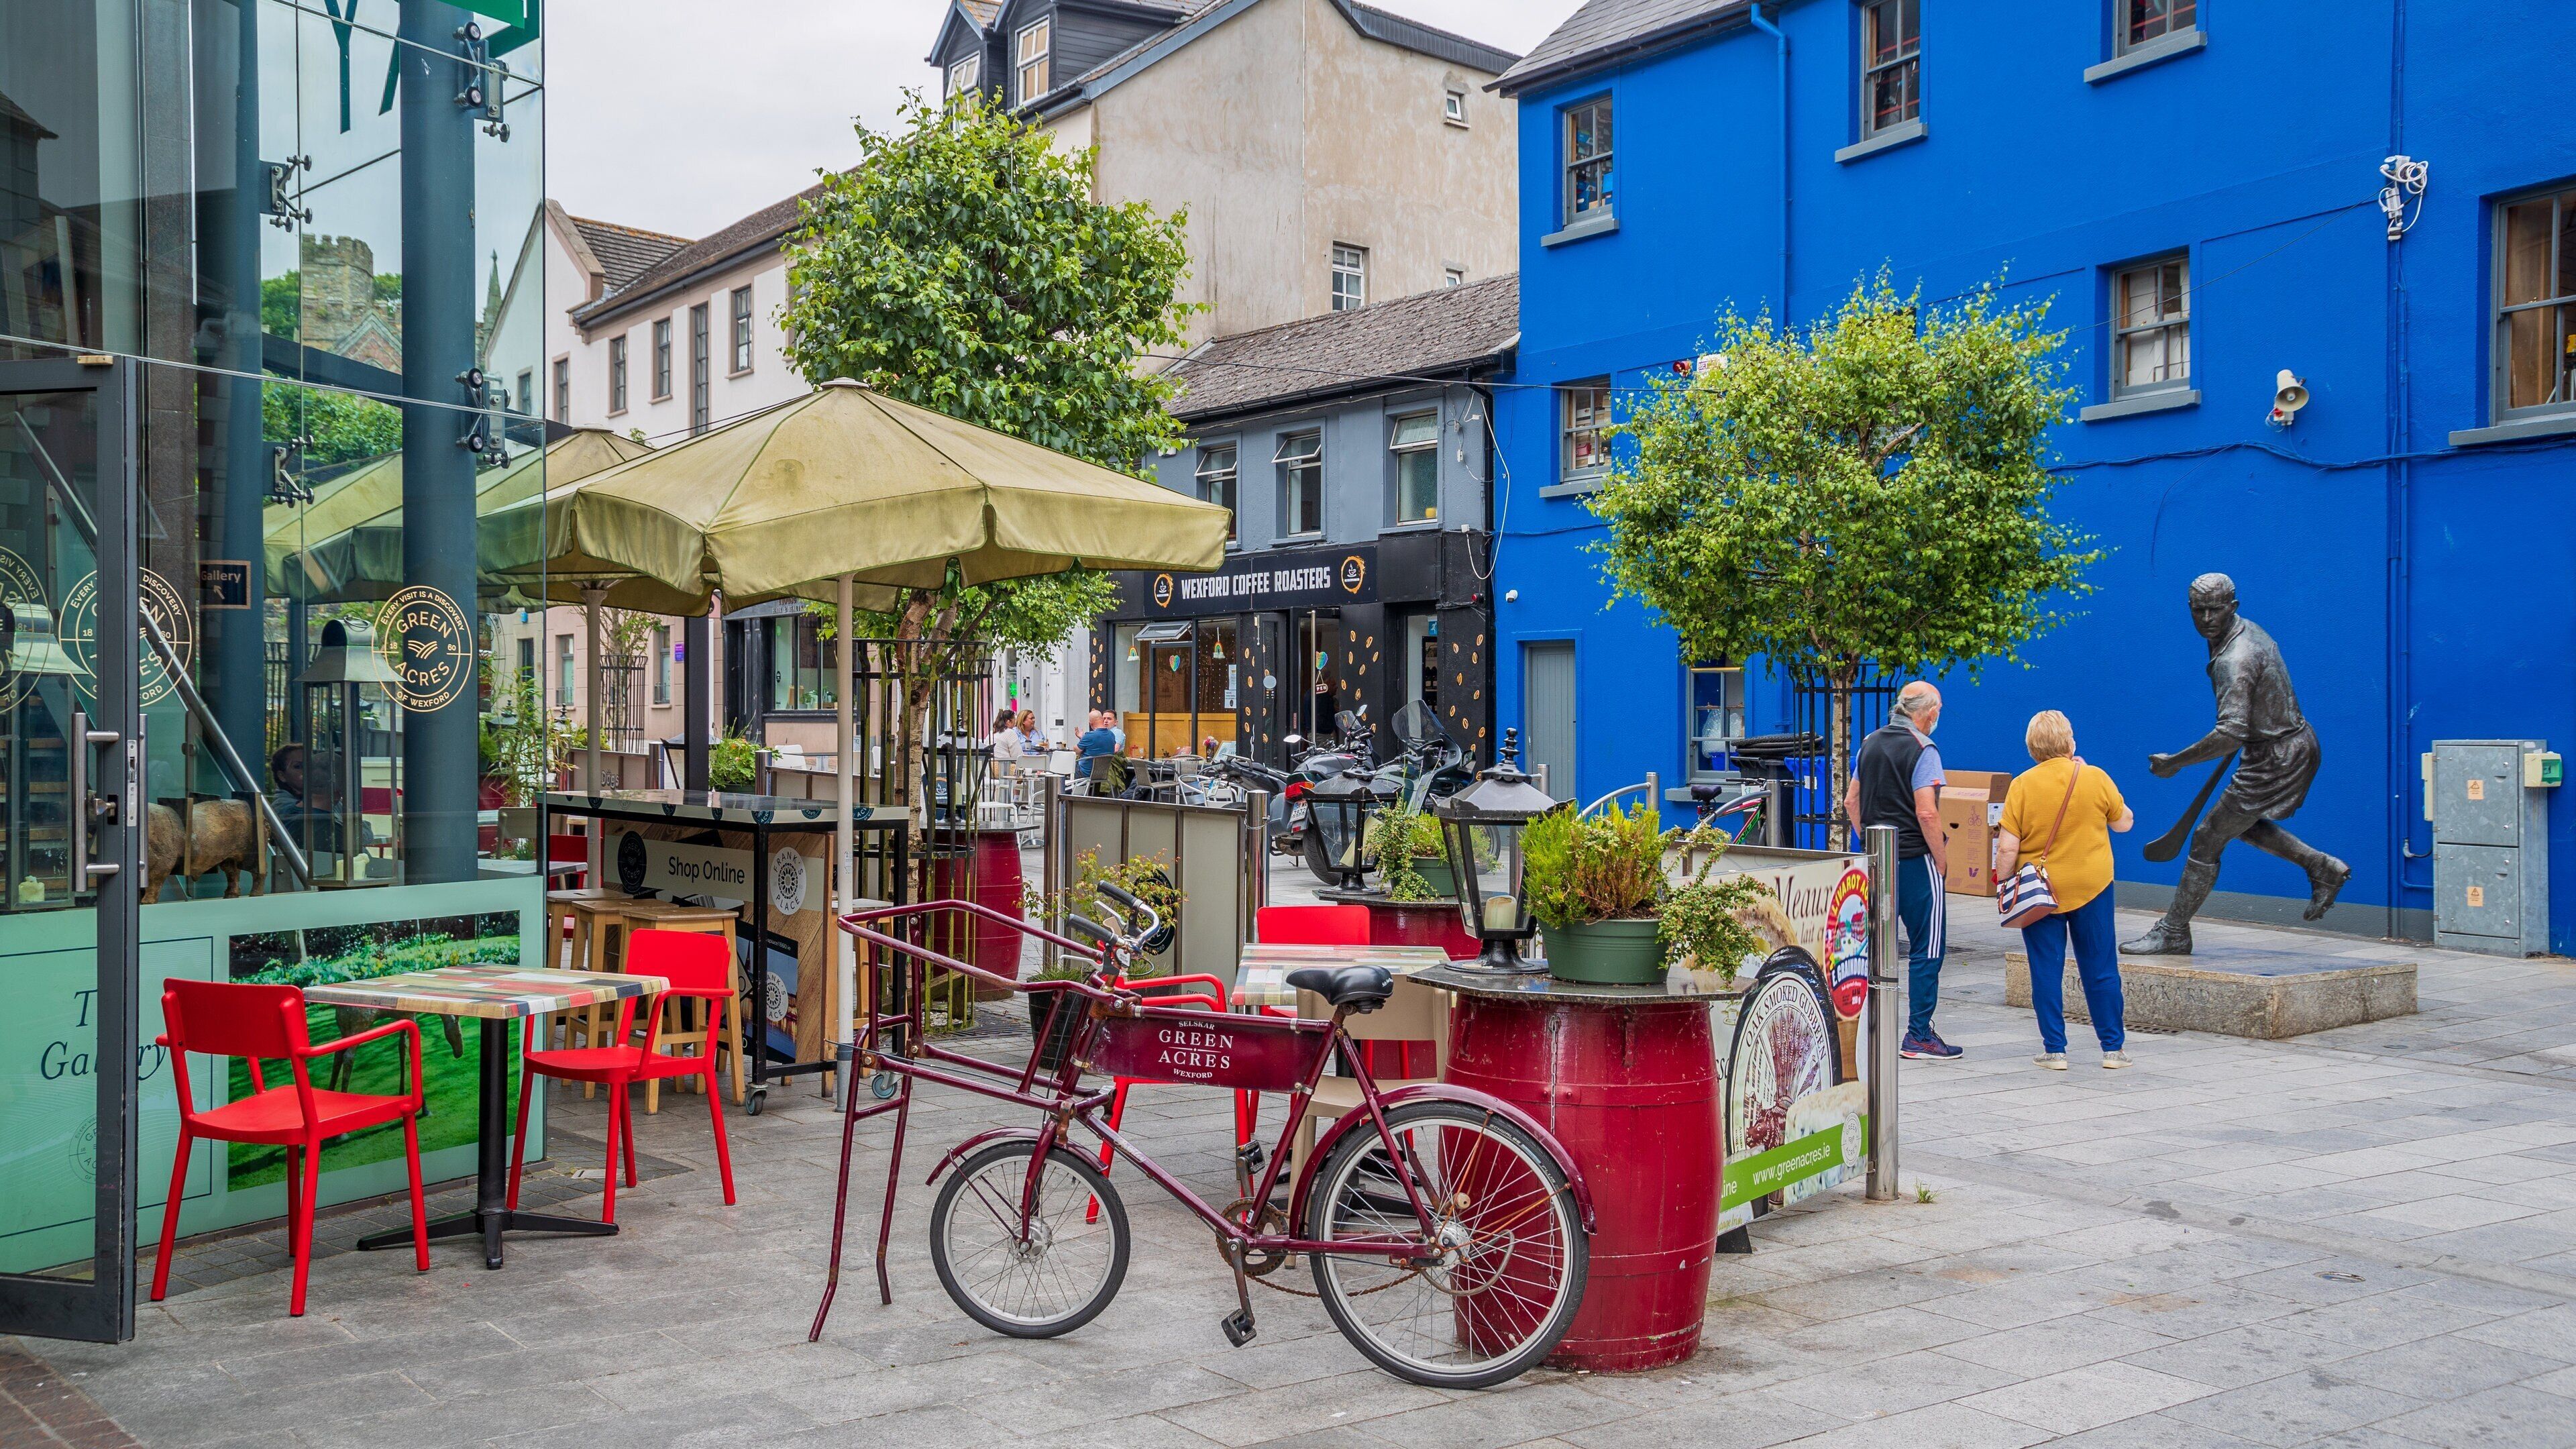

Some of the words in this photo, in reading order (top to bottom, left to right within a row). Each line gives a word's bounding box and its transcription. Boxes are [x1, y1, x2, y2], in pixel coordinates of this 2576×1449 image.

[201, 571, 241, 583] Gallery
[1181, 576, 1229, 600] WEXFORD
[1233, 572, 1269, 595] COFFEE
[1275, 566, 1330, 592] ROASTERS
[70, 582, 95, 608] EVERY
[143, 575, 182, 616] DISCOVERY
[380, 600, 399, 625] EVERY
[399, 591, 417, 603] VISIT
[434, 595, 465, 631] DISCOVERY
[83, 629, 93, 637] 18
[160, 631, 171, 639] 60
[396, 611, 452, 638] GREEN
[394, 661, 449, 686] ACRES
[396, 692, 409, 702] OF
[410, 692, 449, 707] WEXFORD
[668, 857, 699, 883] Shop
[703, 860, 745, 884] Online
[773, 851, 803, 875] FRANK'S
[776, 895, 800, 910] PLACE
[1831, 873, 1861, 916] LIVAROT
[767, 974, 786, 996] ANK'S
[2126, 981, 2210, 1006] RACKARD
[769, 1010, 782, 1019] ACE
[1179, 1021, 1215, 1030] SELSKAR
[1746, 1010, 1764, 1049] OAK
[1764, 985, 1798, 1014] SMOKED
[1799, 993, 1826, 1061] GUBBEEN
[1159, 1029, 1234, 1049] GREEN
[1159, 1050, 1230, 1069] ACRES
[1173, 1068, 1213, 1079] WEXFORD
[1753, 1142, 1831, 1185] www.greenacres.ie
